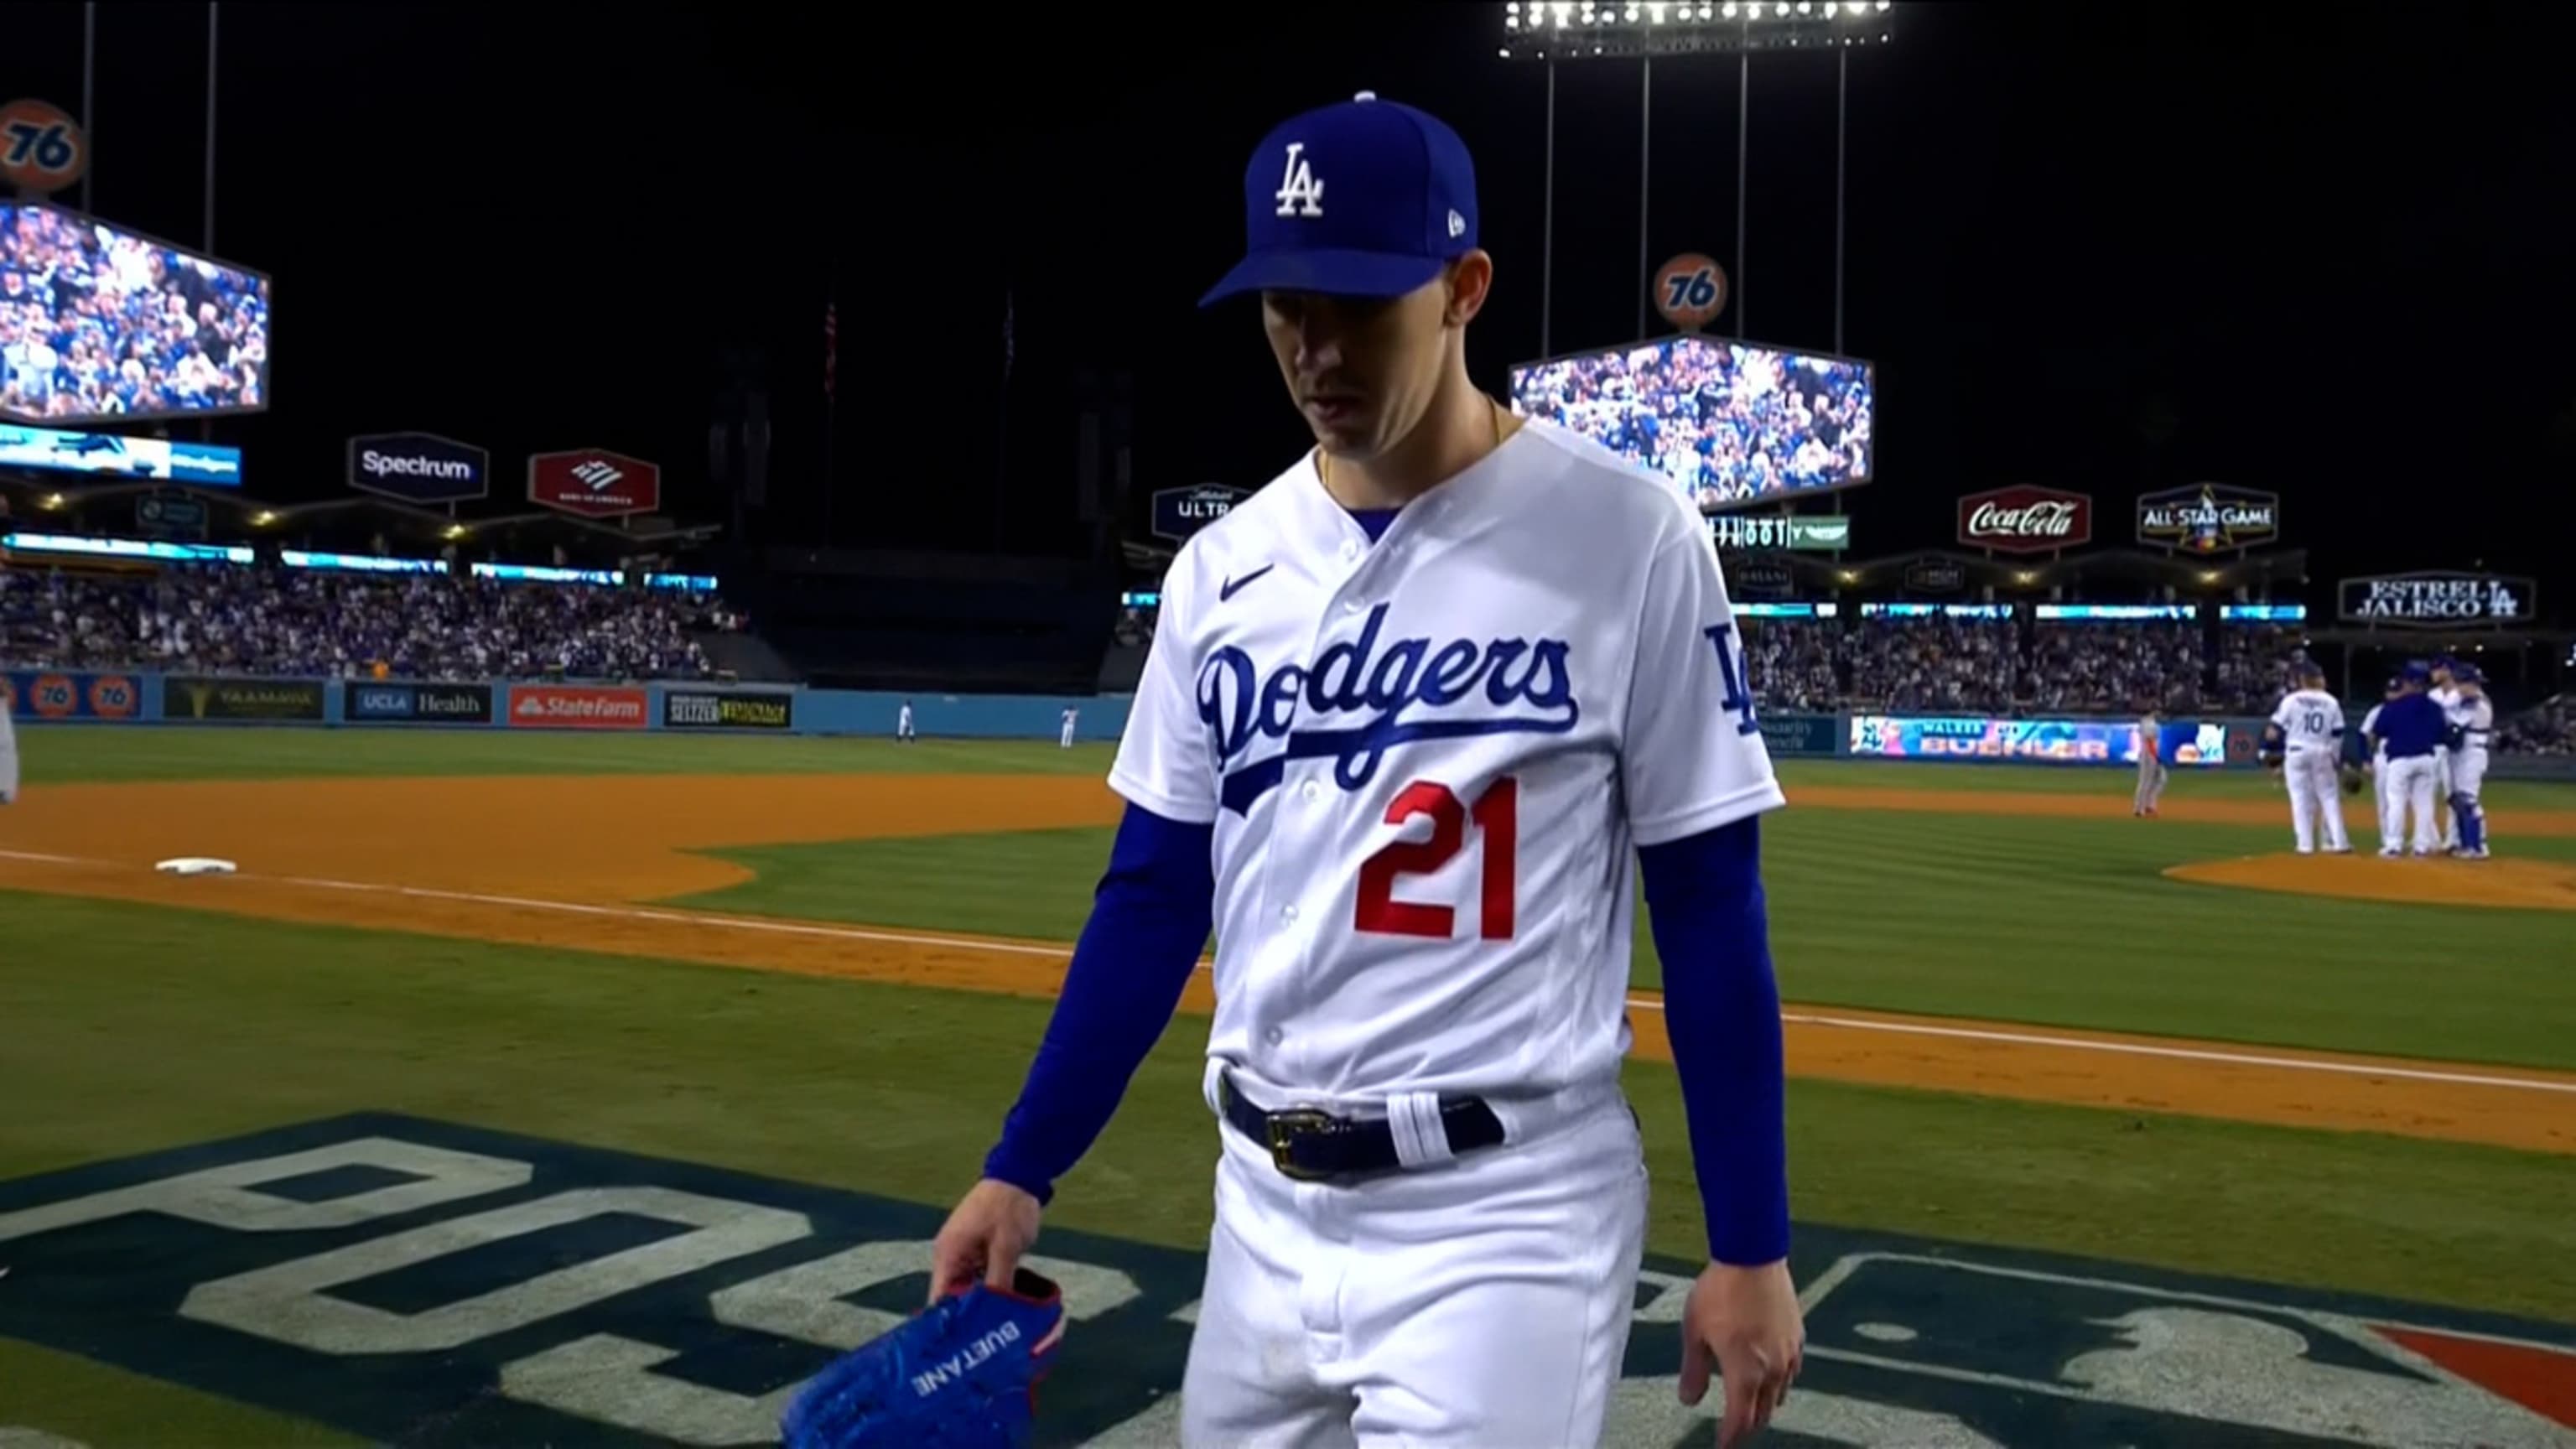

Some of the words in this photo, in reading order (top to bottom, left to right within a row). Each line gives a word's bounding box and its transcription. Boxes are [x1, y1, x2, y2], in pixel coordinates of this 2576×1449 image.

[5, 121, 74, 171] 76
[1276, 142, 1325, 216] LA
[1666, 267, 1717, 309] 76
[362, 449, 470, 478] Spectrum
[2221, 506, 2272, 524] GAME
[2355, 599, 2480, 617] JALISCO
[42, 686, 69, 706] 76
[101, 686, 127, 707] 76
[363, 693, 407, 710] UCLA
[420, 693, 481, 713] Health
[1197, 601, 1578, 791] Dodgers
[2303, 712, 2324, 734] 10
[1354, 776, 1518, 940] 21
[911, 1320, 1021, 1397] BUETANE
